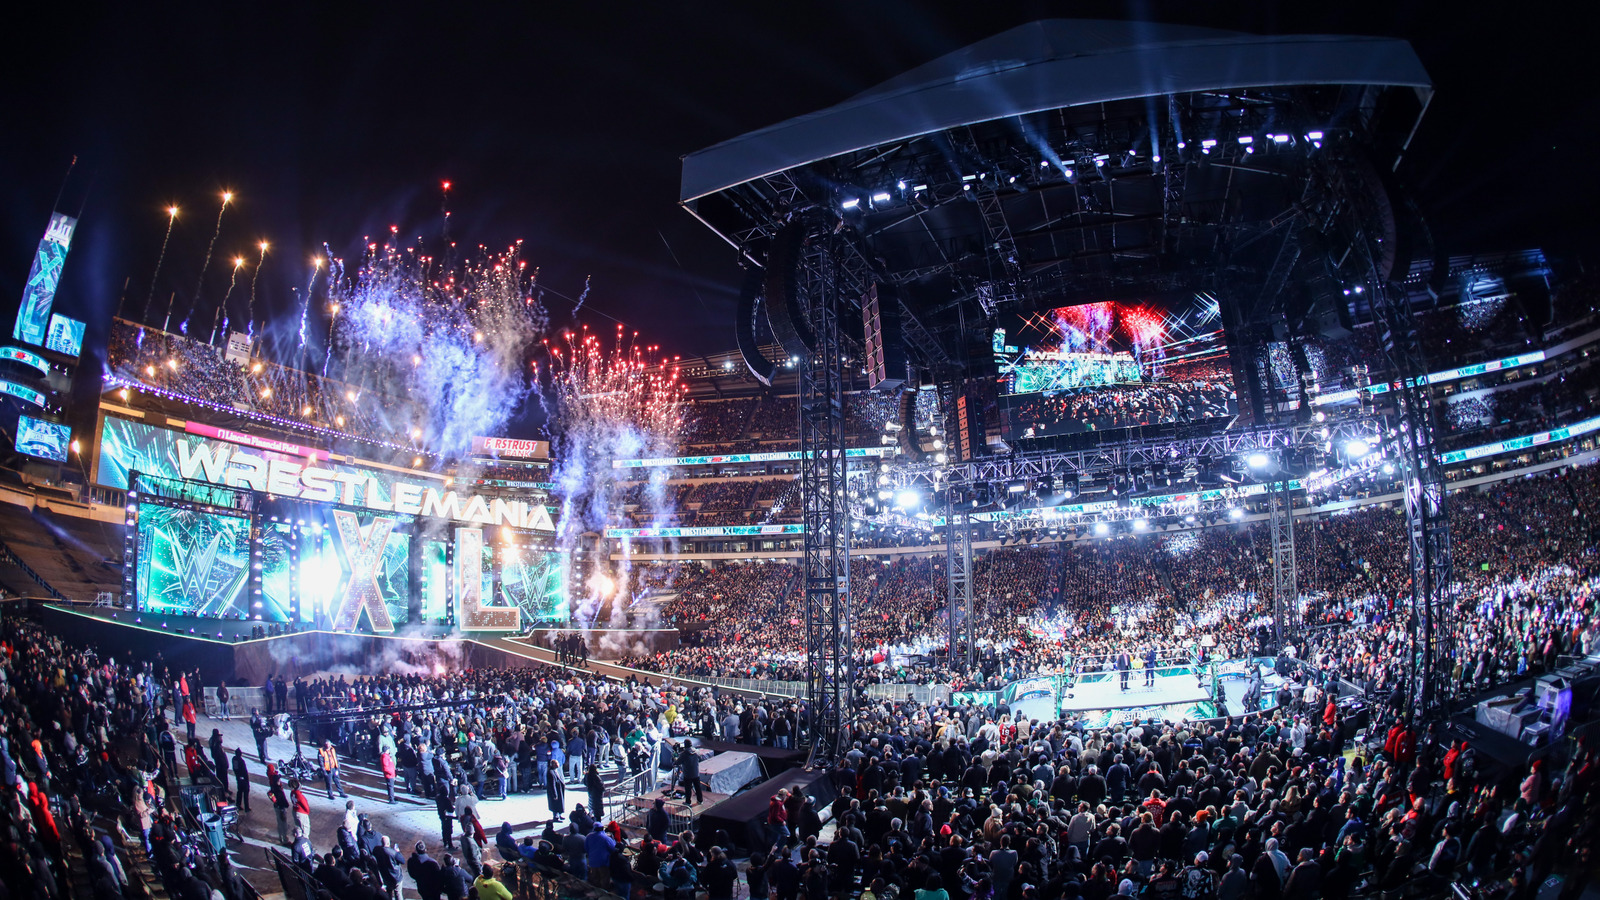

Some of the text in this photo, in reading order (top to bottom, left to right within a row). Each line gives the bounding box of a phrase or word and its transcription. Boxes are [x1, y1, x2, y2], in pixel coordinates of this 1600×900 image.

[225, 432, 300, 454] Lincoln Financial Field
[506, 449, 530, 458] BANK
[750, 452, 788, 461] WRESTLEMANIA
[176, 438, 556, 531] WRESTLEMANIA
[680, 527, 723, 536] WRESTLEMANIA
[1001, 729, 1010, 737] 19
